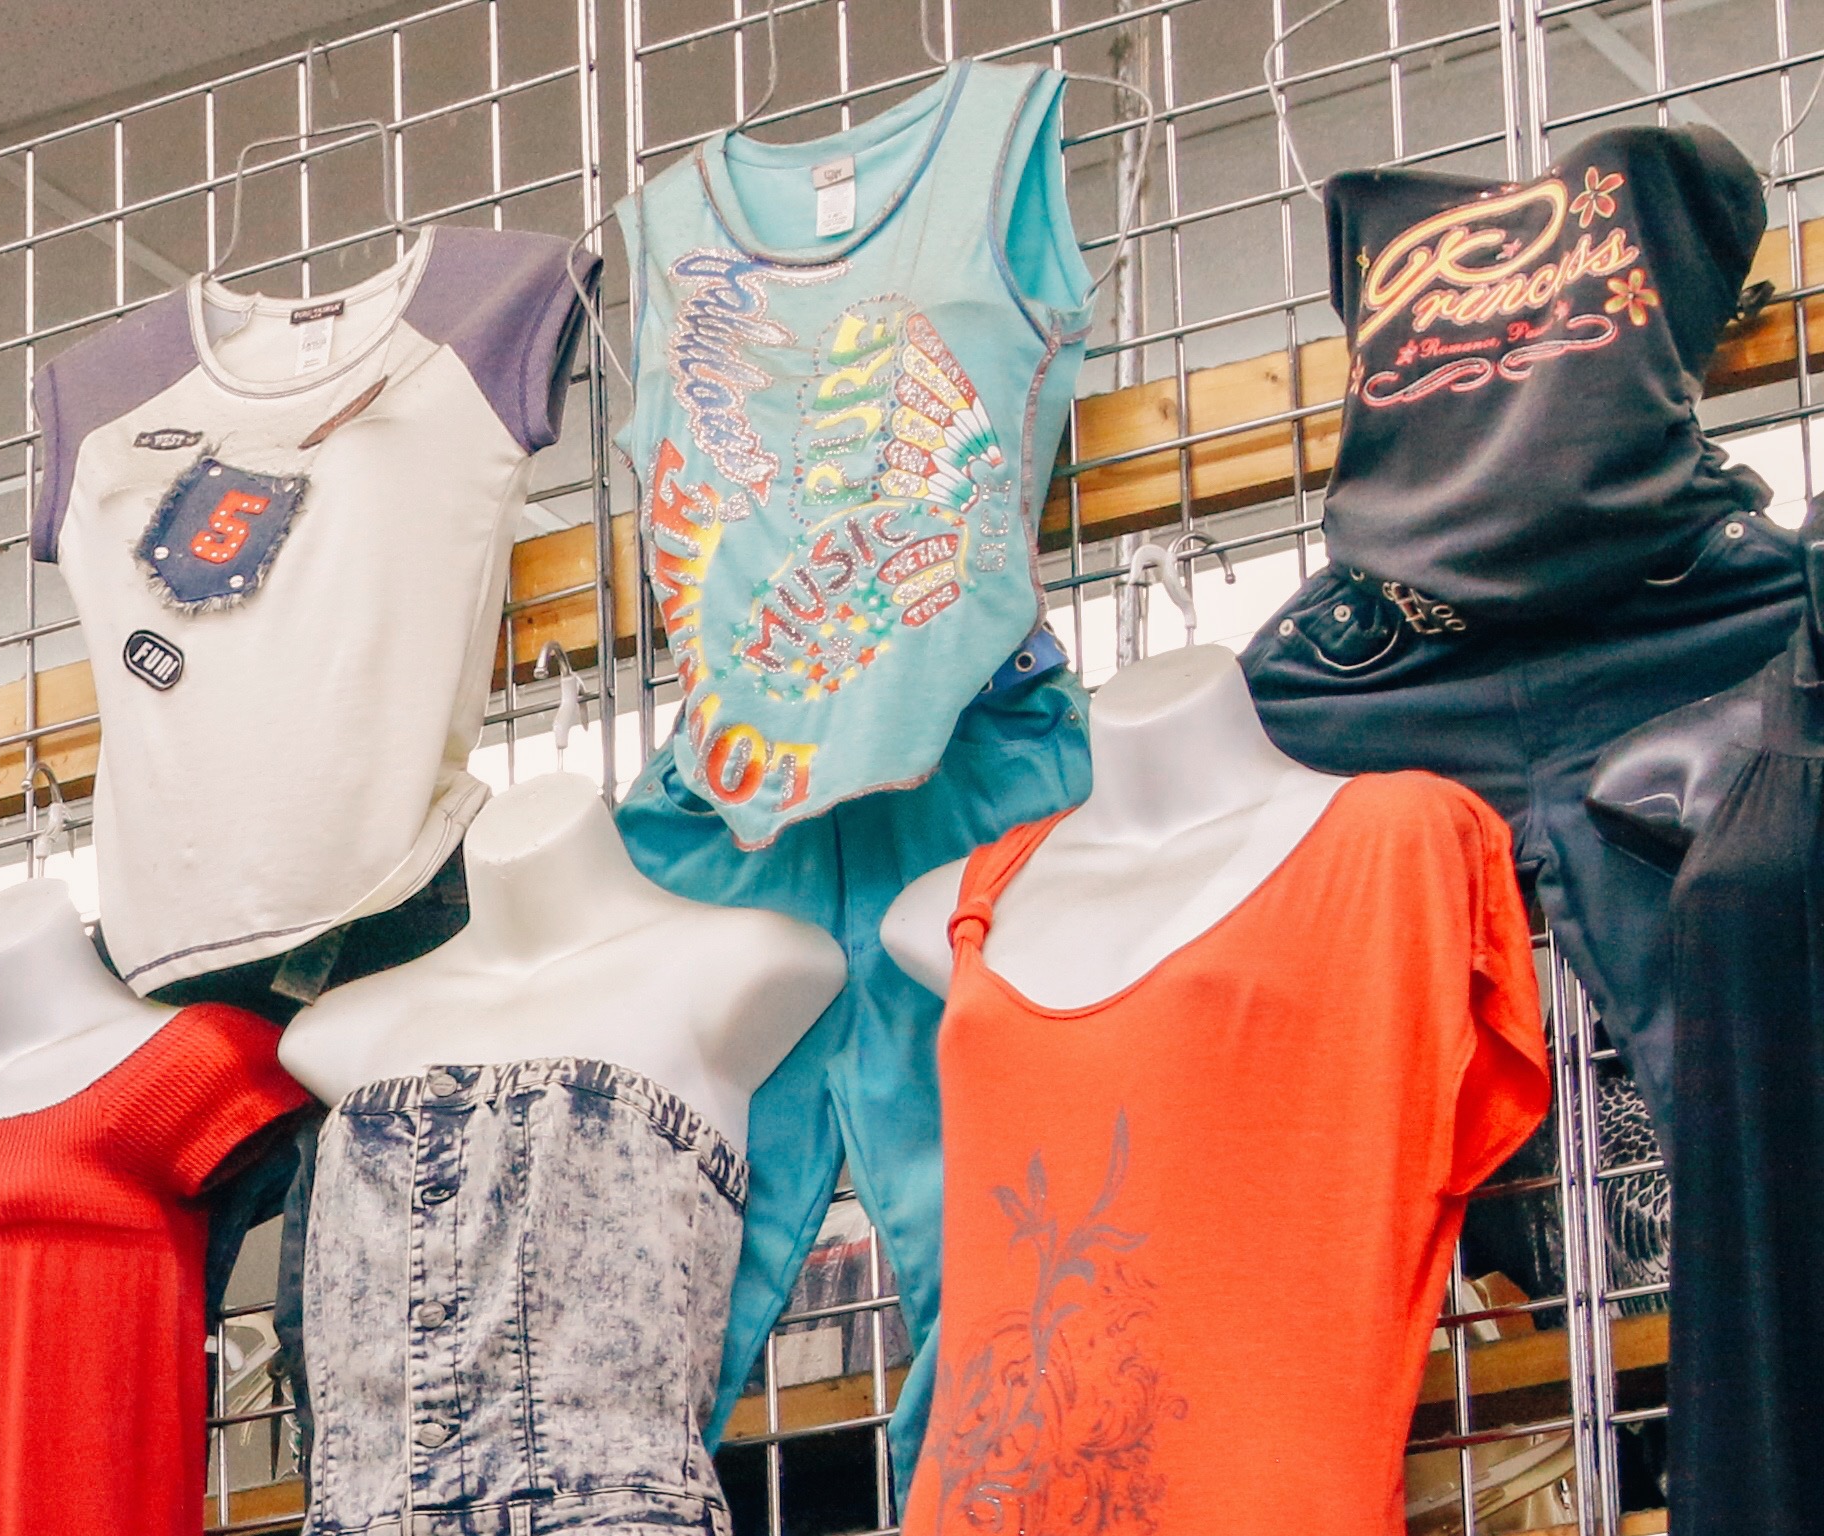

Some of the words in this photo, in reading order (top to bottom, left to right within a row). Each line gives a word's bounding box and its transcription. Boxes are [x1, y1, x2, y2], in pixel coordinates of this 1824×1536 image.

[1355, 178, 1640, 346] Princss
[801, 308, 908, 508] PURE
[190, 489, 272, 565] 5
[740, 508, 919, 676] MUSIC
[131, 641, 180, 682] FUN!
